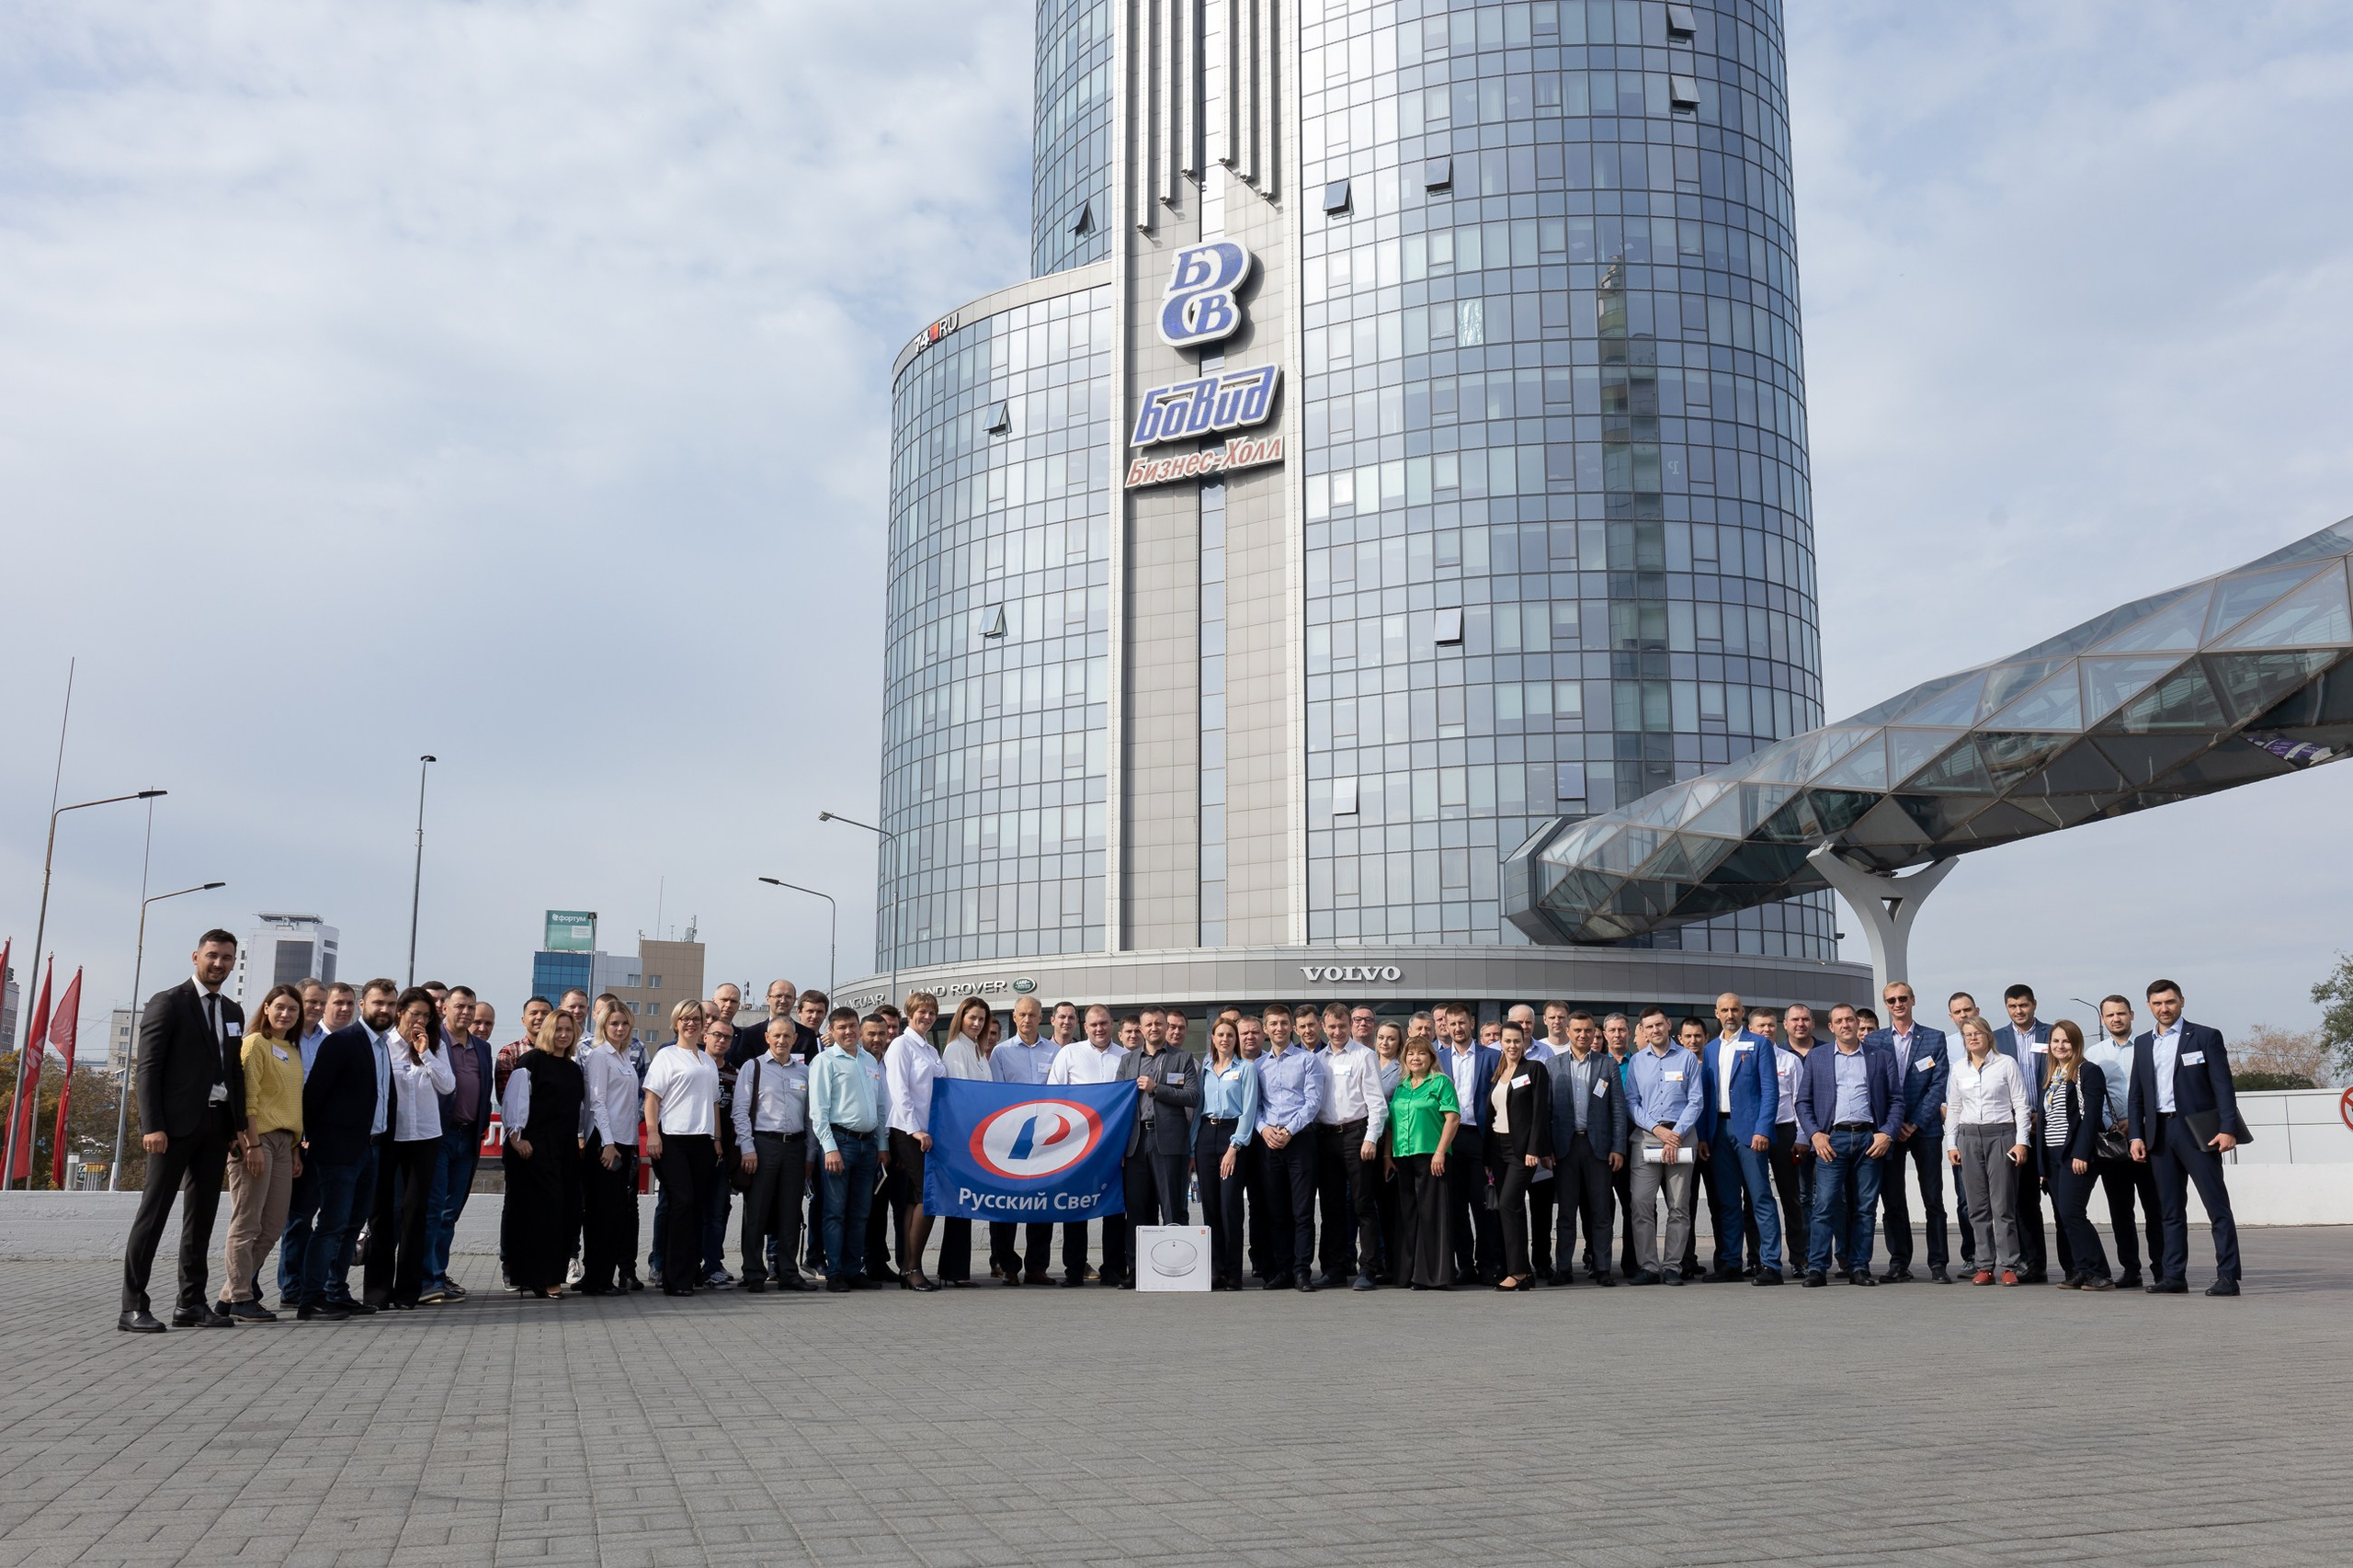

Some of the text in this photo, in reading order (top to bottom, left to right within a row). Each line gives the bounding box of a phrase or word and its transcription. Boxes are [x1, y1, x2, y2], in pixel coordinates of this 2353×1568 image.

[1127, 437, 1281, 486] Бизнес-Холл
[559, 915, 586, 923] фортум
[1300, 965, 1401, 981] VOLVO
[950, 980, 1006, 994] ROVER
[959, 1187, 1101, 1211] Русский Свет
